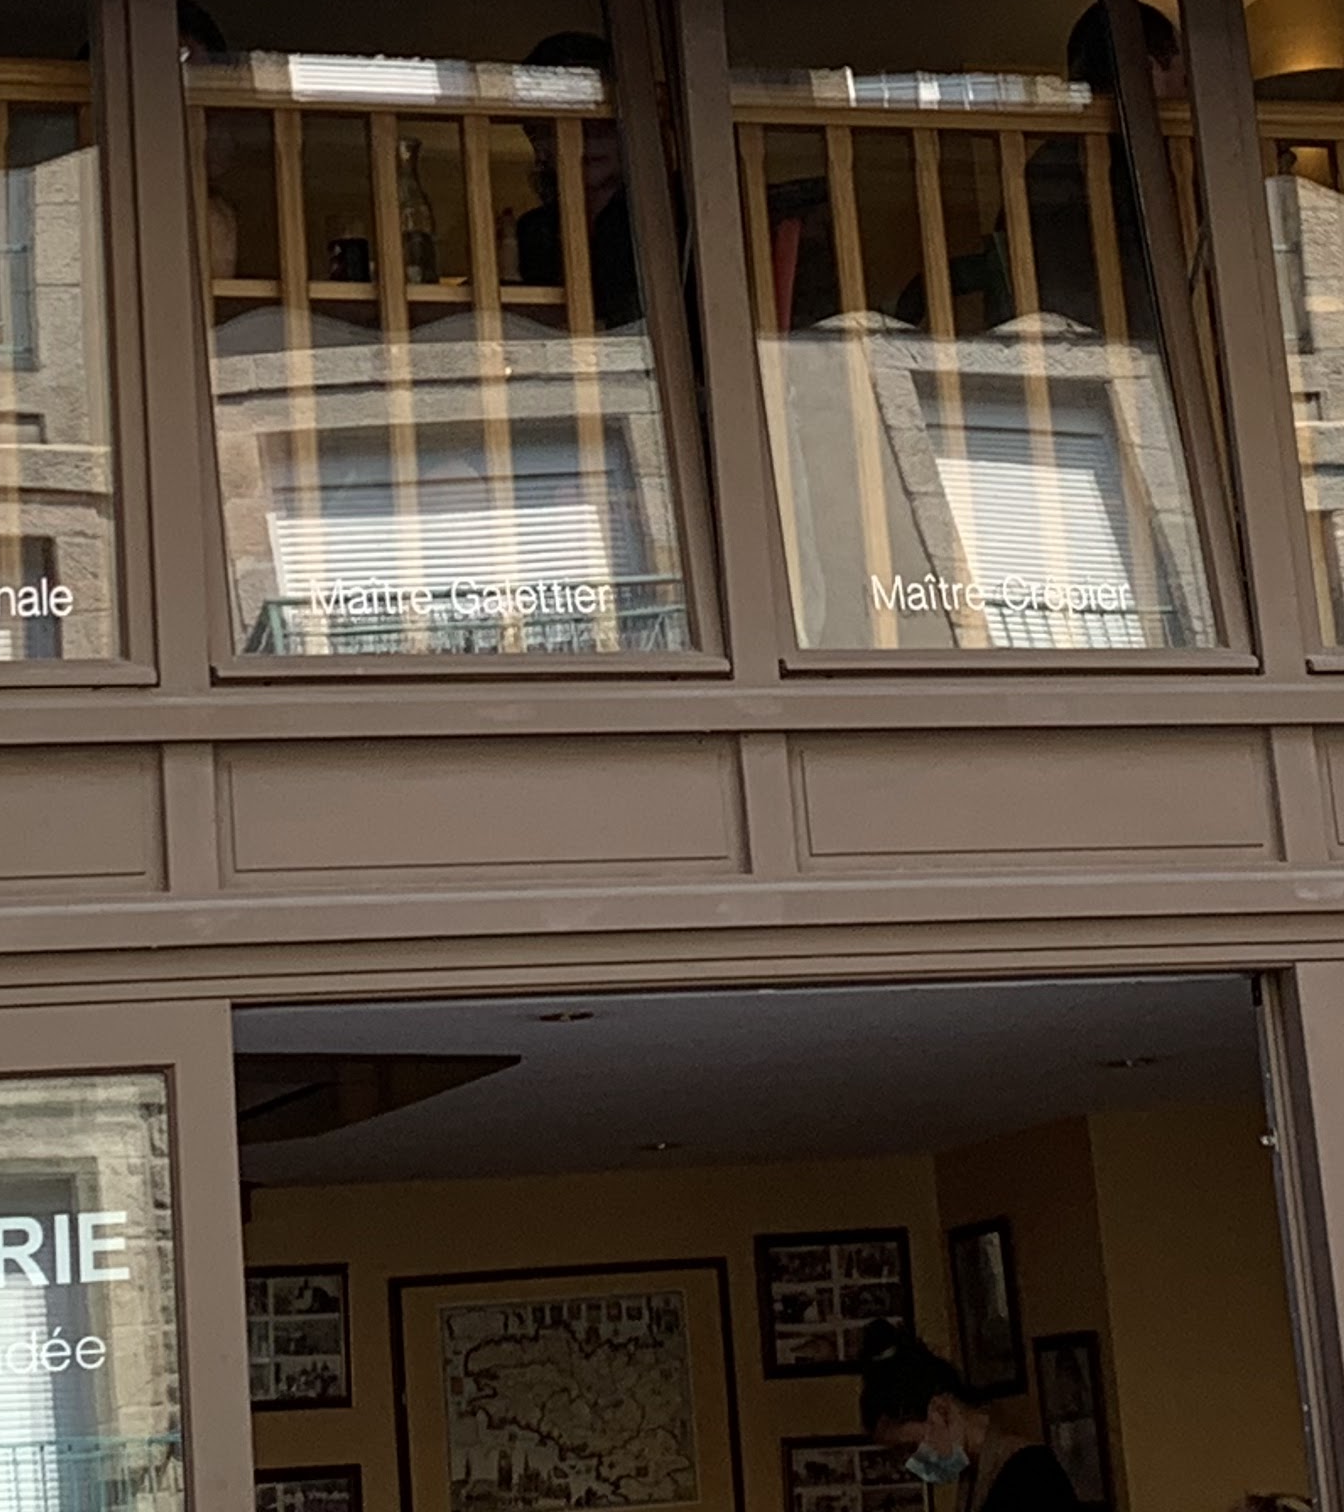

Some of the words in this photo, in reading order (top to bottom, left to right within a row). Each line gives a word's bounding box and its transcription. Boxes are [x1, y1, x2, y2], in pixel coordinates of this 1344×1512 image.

[309, 577, 434, 615] Maître
[450, 576, 613, 614] Galettier
[871, 574, 986, 611] Maître
